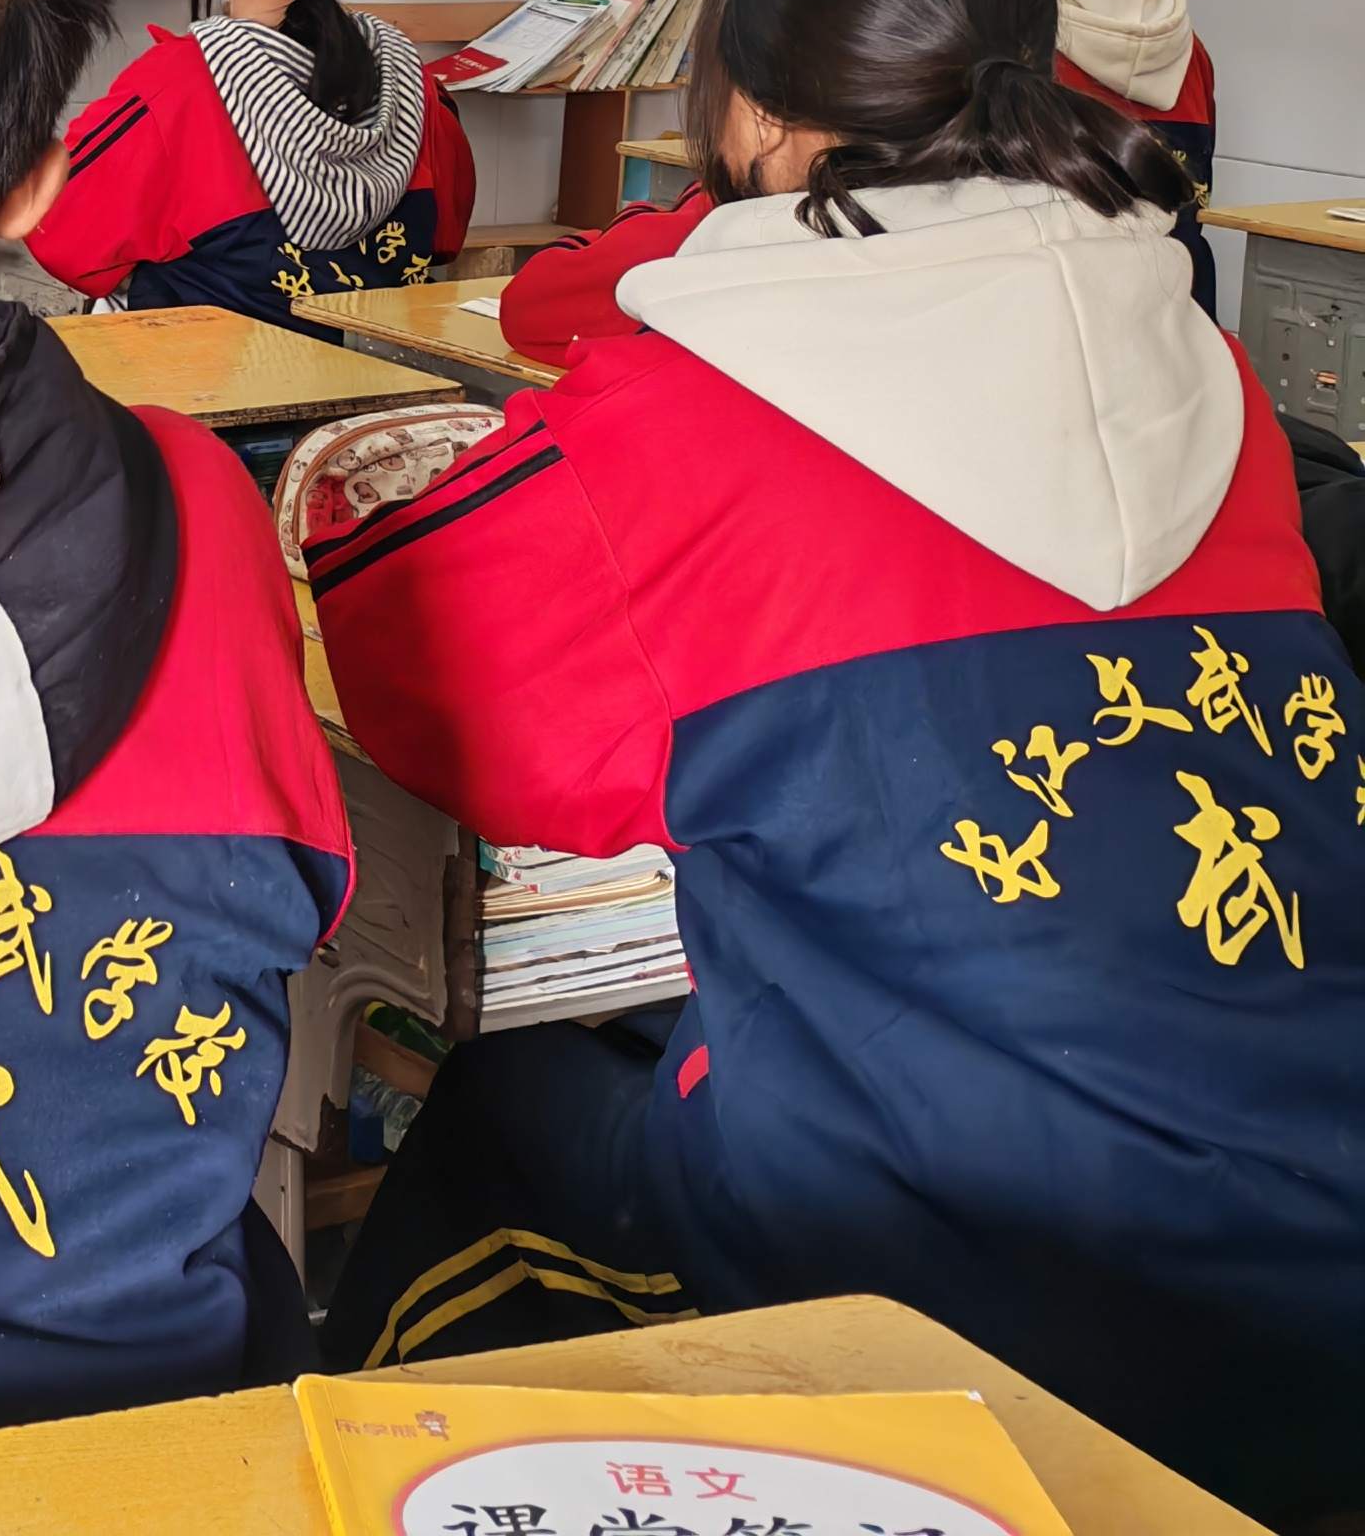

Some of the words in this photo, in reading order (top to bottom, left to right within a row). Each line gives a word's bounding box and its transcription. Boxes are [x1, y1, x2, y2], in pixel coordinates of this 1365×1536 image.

[940, 624, 1365, 903] 长江文武学
[1173, 770, 1304, 969] 武
[443, 1504, 941, 1536] 课堂
[606, 1461, 757, 1501] 语文
